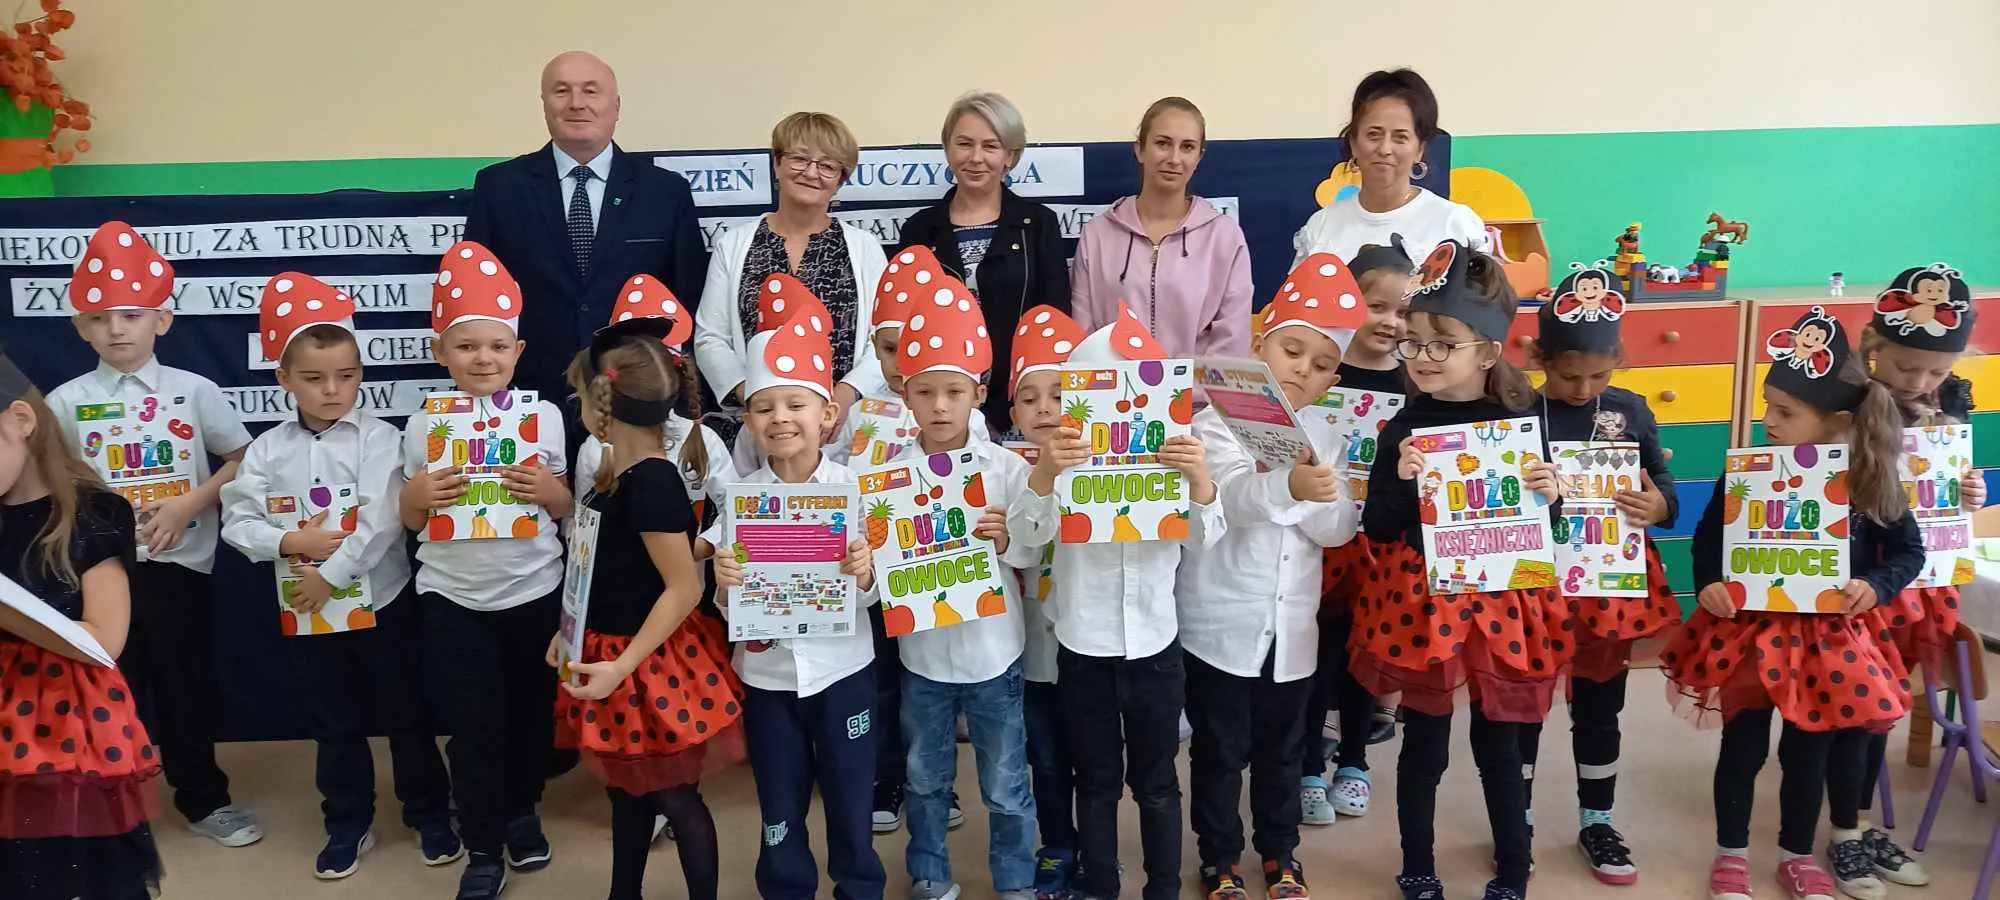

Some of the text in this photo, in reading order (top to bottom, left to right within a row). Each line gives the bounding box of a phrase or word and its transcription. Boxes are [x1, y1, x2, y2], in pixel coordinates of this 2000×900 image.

[685, 161, 755, 192] ZIEŃ
[213, 228, 260, 251] ZA
[275, 224, 412, 253] TRUDNĄ
[1069, 373, 1086, 388] 3+
[433, 400, 448, 412] 3+
[452, 431, 517, 465] DUŻO
[1091, 412, 1165, 456] DUŻO
[107, 434, 174, 470] DUŻO
[866, 476, 883, 491] 3+
[1072, 472, 1182, 505] OWOCE
[1447, 468, 1520, 511] DUŻO
[735, 492, 781, 514] DUŻO
[1749, 491, 1821, 530] DUŻO
[896, 502, 967, 549] DUŻO
[1434, 523, 1544, 560] KSIĘŻNICZKI
[1552, 516, 1620, 552] DUŻO
[888, 552, 992, 597] OWOCE
[1731, 547, 1840, 577] OWOCE
